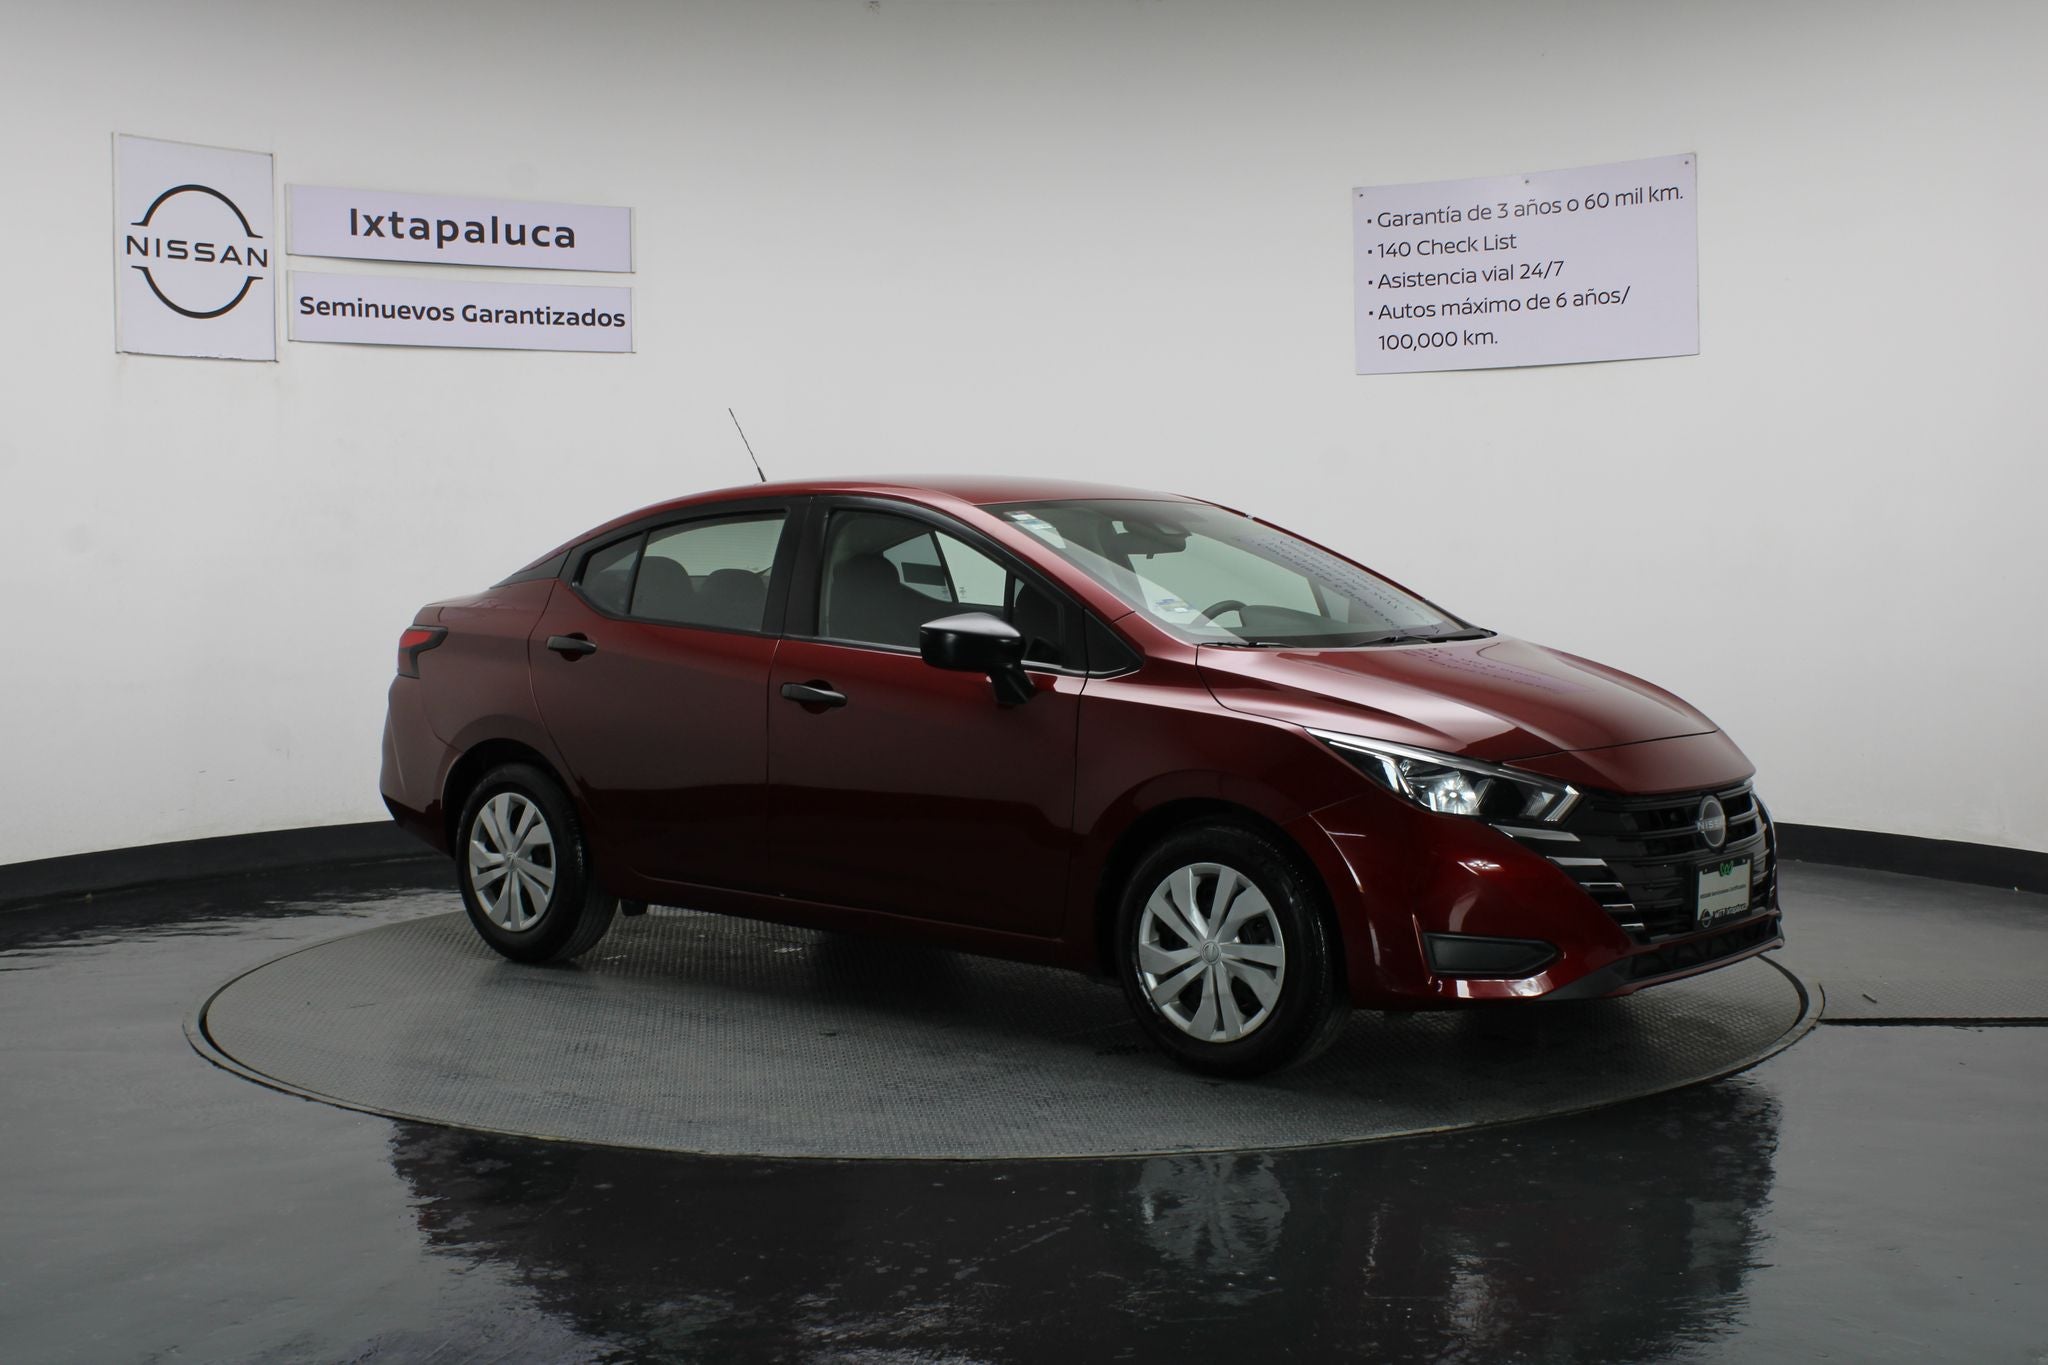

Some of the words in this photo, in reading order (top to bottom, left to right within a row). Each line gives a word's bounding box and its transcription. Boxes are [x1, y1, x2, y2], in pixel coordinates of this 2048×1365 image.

[1377, 205, 1462, 228] Garantía
[1468, 204, 1492, 221] de
[1497, 202, 1509, 219] 3
[1514, 198, 1562, 217] años
[1566, 198, 1580, 212] o
[1584, 192, 1610, 209] 60
[1615, 187, 1643, 207] mil
[1648, 185, 1684, 203] km.
[350, 207, 575, 249] Ixtapaluca
[127, 235, 268, 268] NISSAN
[1377, 241, 1412, 259] 140
[1416, 236, 1479, 256] Check
[1483, 233, 1518, 251] List
[1377, 267, 1477, 289] Asistencia
[1481, 263, 1514, 284] vial
[1519, 260, 1565, 280] 24/7
[299, 296, 455, 322] Seminuevos
[461, 304, 626, 328] Garantizados
[1377, 303, 1437, 320] Autos
[1441, 297, 1521, 318] máximo
[1526, 294, 1551, 311] de
[1556, 291, 1568, 308] 6
[1572, 285, 1631, 307] años/
[1378, 332, 1458, 352] 100,000
[1463, 330, 1498, 347] km.
